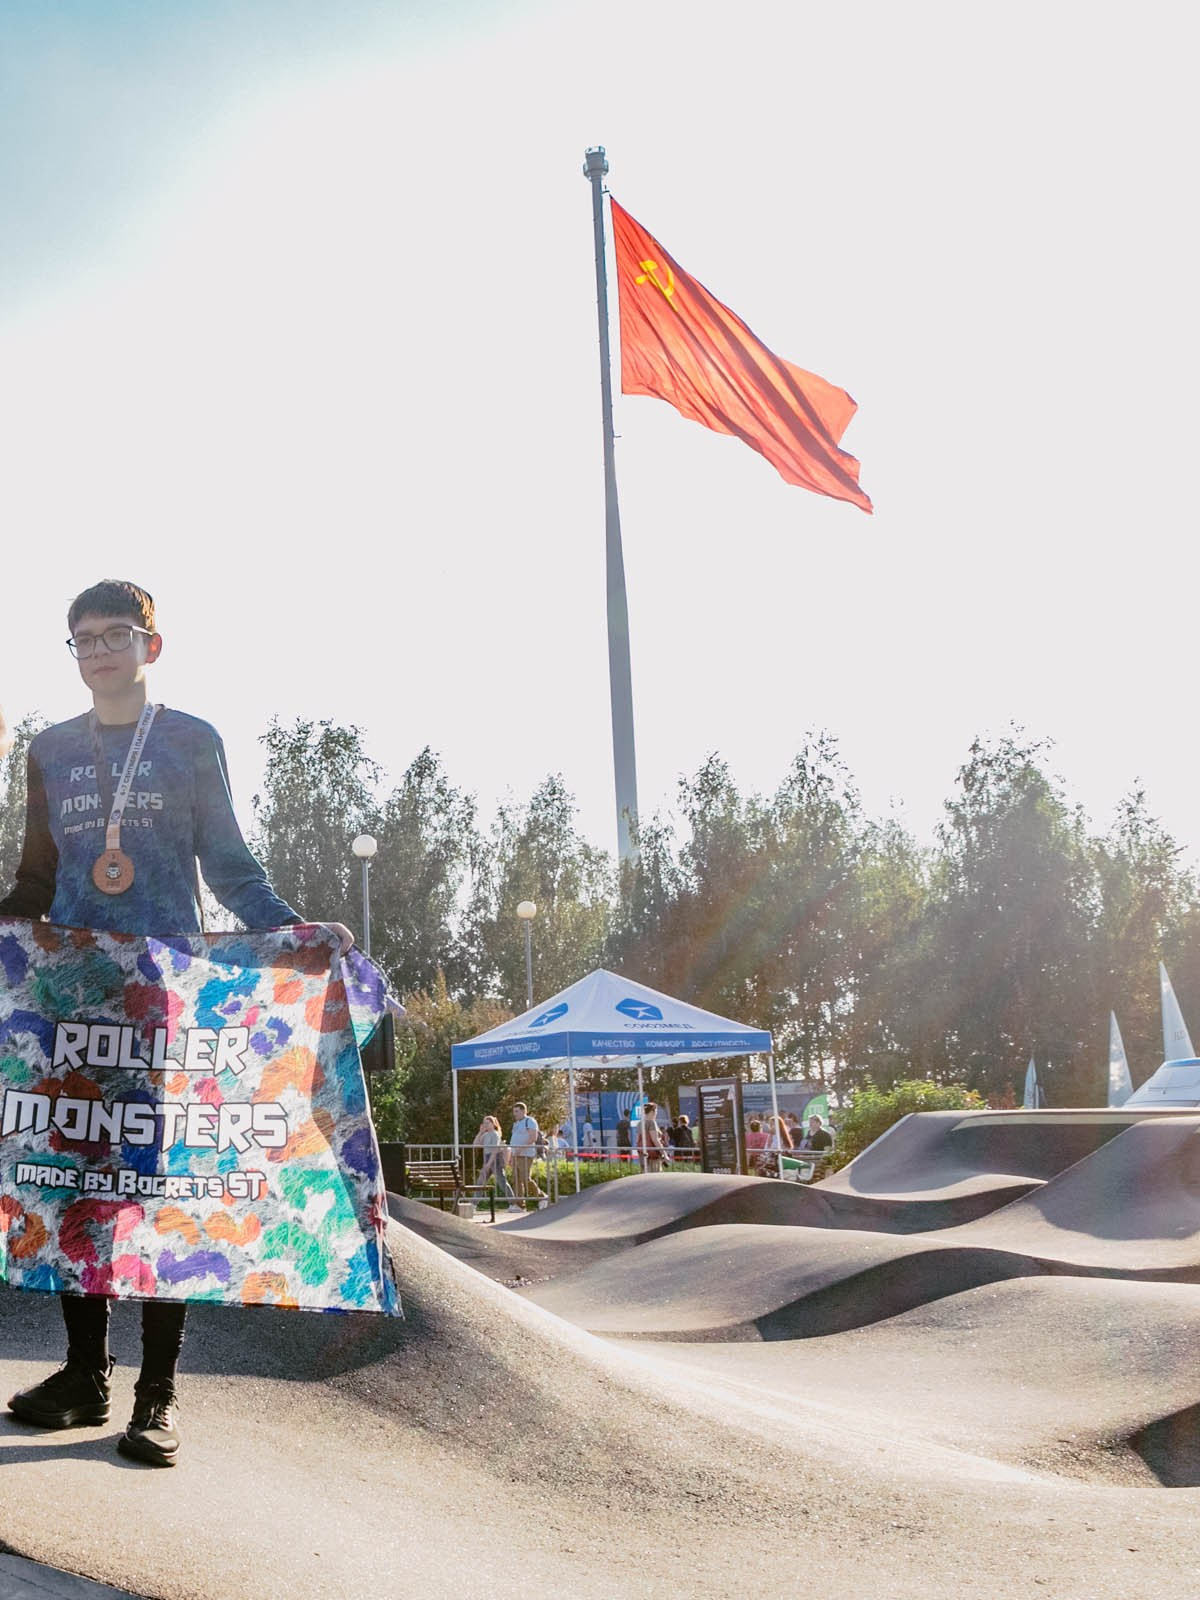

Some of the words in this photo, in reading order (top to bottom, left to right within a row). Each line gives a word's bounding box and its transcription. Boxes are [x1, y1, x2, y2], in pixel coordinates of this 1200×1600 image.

[70, 760, 152, 783] ROLR
[60, 792, 163, 819] MONERS
[52, 1022, 249, 1077] ROLLER
[591, 1039, 635, 1048] КАЧЕСТВО
[645, 1040, 685, 1048] КОМФОРТ
[1, 1089, 288, 1154] MONSTERS
[16, 1163, 79, 1188] MADE
[84, 1171, 114, 1192] BY
[227, 1171, 267, 1199] ST
